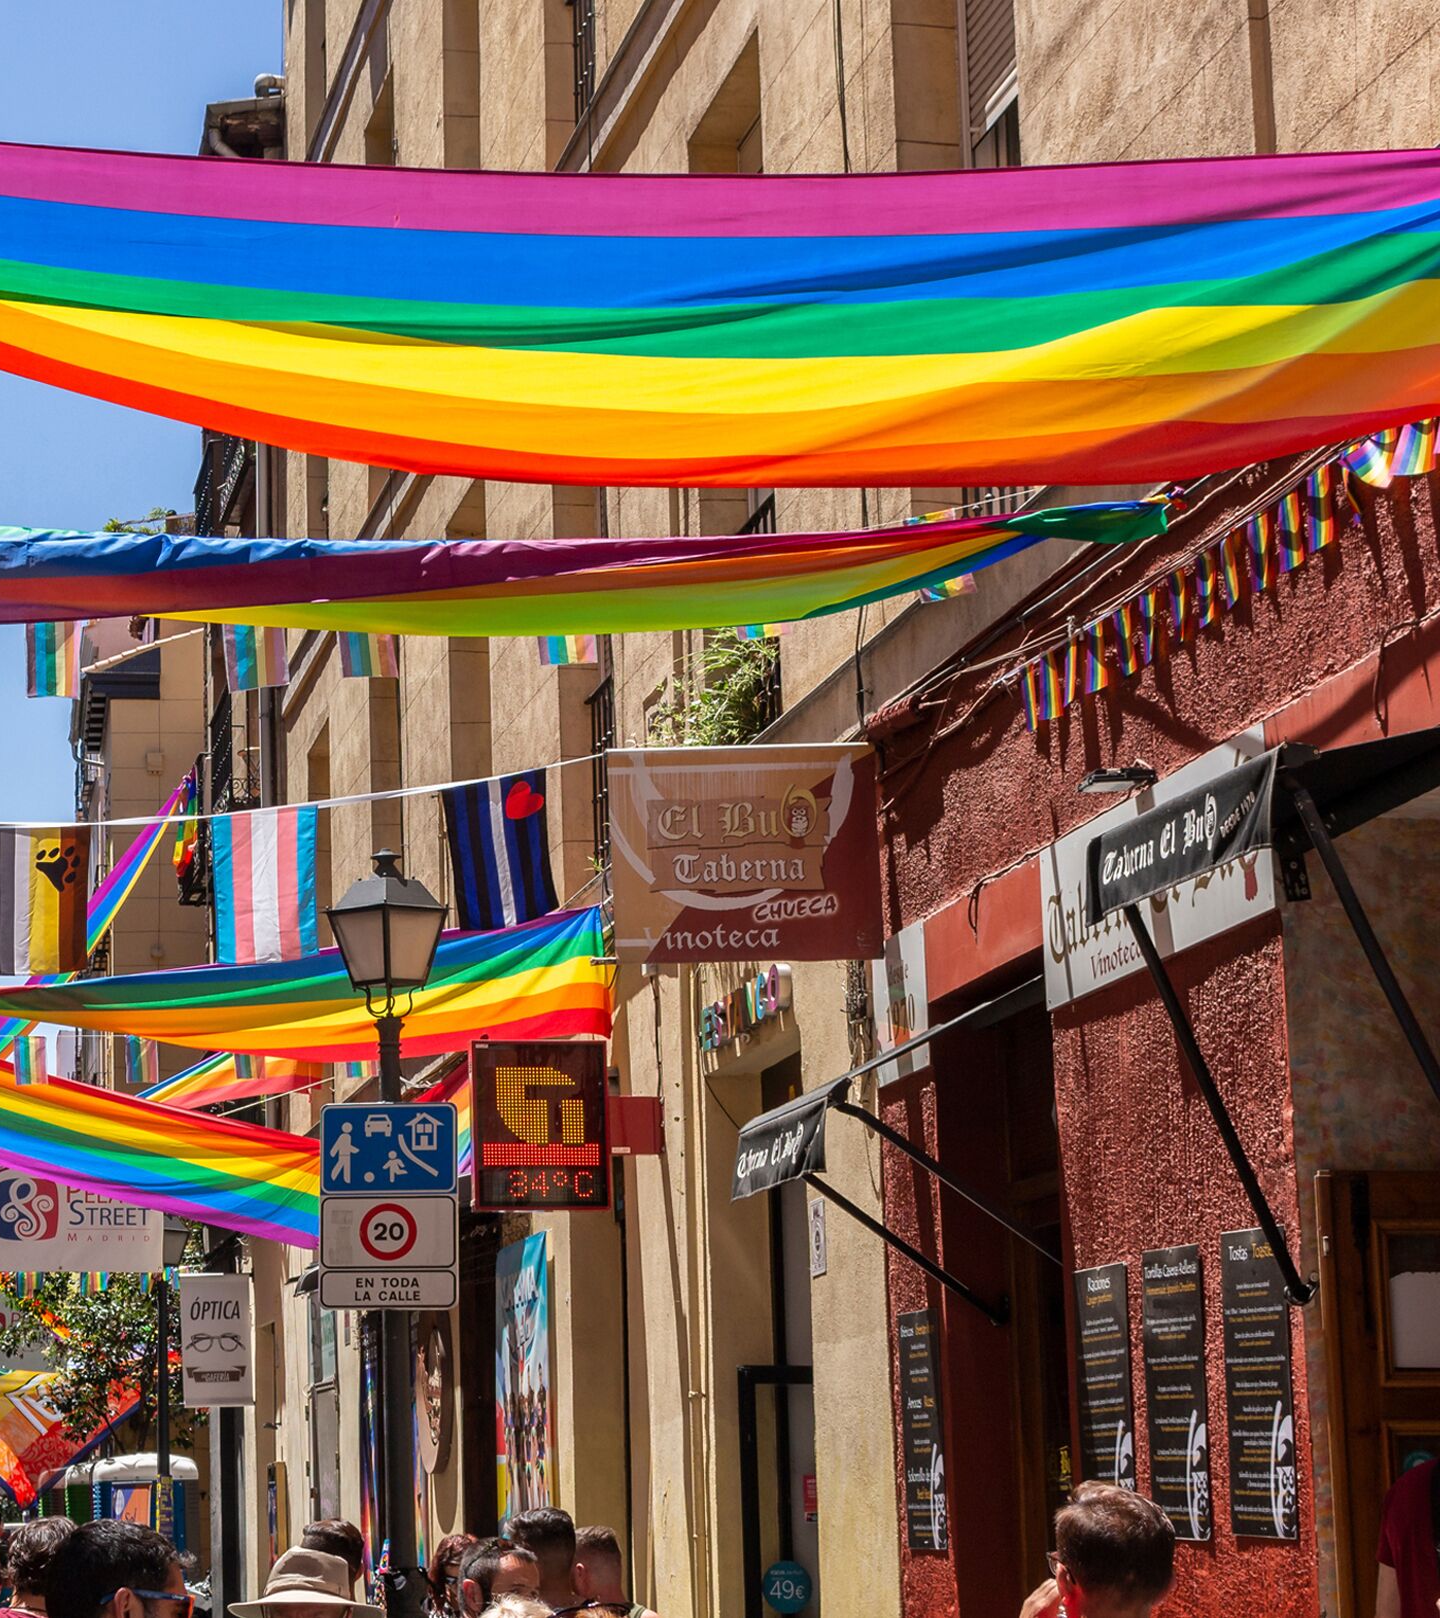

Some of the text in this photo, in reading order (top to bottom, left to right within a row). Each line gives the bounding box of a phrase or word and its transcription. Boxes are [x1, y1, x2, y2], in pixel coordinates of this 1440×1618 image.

[659, 801, 705, 841] El
[1219, 808, 1242, 839] DESDE
[1102, 839, 1155, 886] Taberna
[1160, 819, 1176, 860] El
[671, 852, 806, 885] Taberna
[754, 896, 838, 922] CHUECA
[886, 992, 915, 1043] 1970
[373, 1222, 404, 1241] 20
[355, 1278, 419, 1288] EN TODA
[355, 1291, 421, 1301] LA CALLE
[190, 1296, 241, 1321] ÓPTICA
[769, 1580, 805, 1600] 49€
